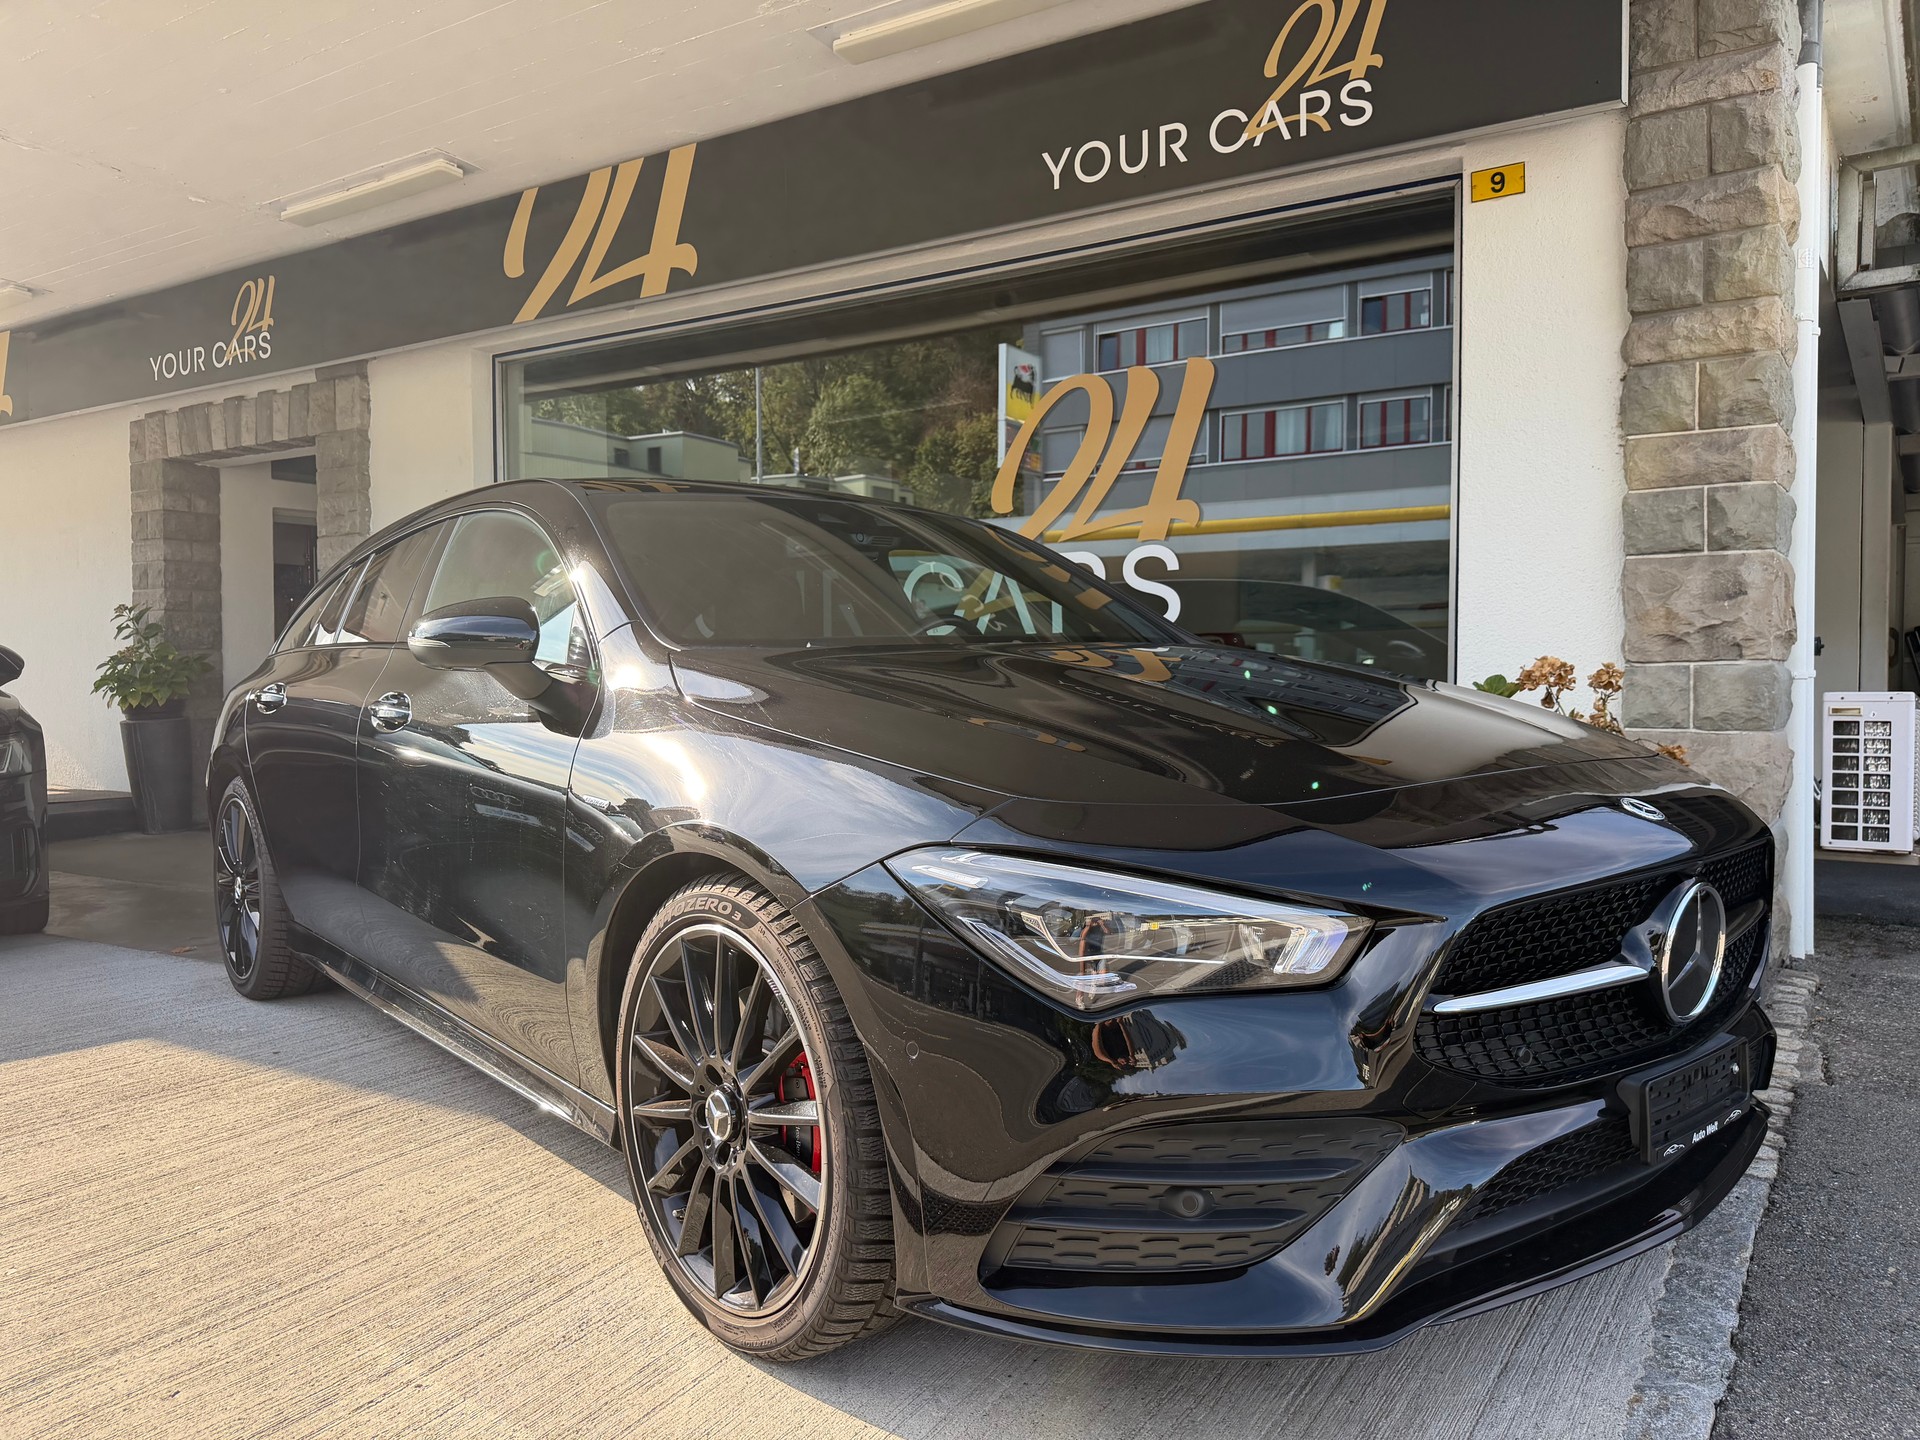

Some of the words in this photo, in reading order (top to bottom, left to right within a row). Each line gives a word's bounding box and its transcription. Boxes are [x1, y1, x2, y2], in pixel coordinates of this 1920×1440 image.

[1244, 0, 1383, 139] 24
[1041, 121, 1188, 190] YOUR
[1208, 79, 1373, 154] CARS
[1490, 171, 1505, 194] 9
[225, 275, 276, 361] 24
[149, 346, 206, 381] YOUR
[212, 331, 271, 368] CARS
[731, 910, 742, 921] 3
